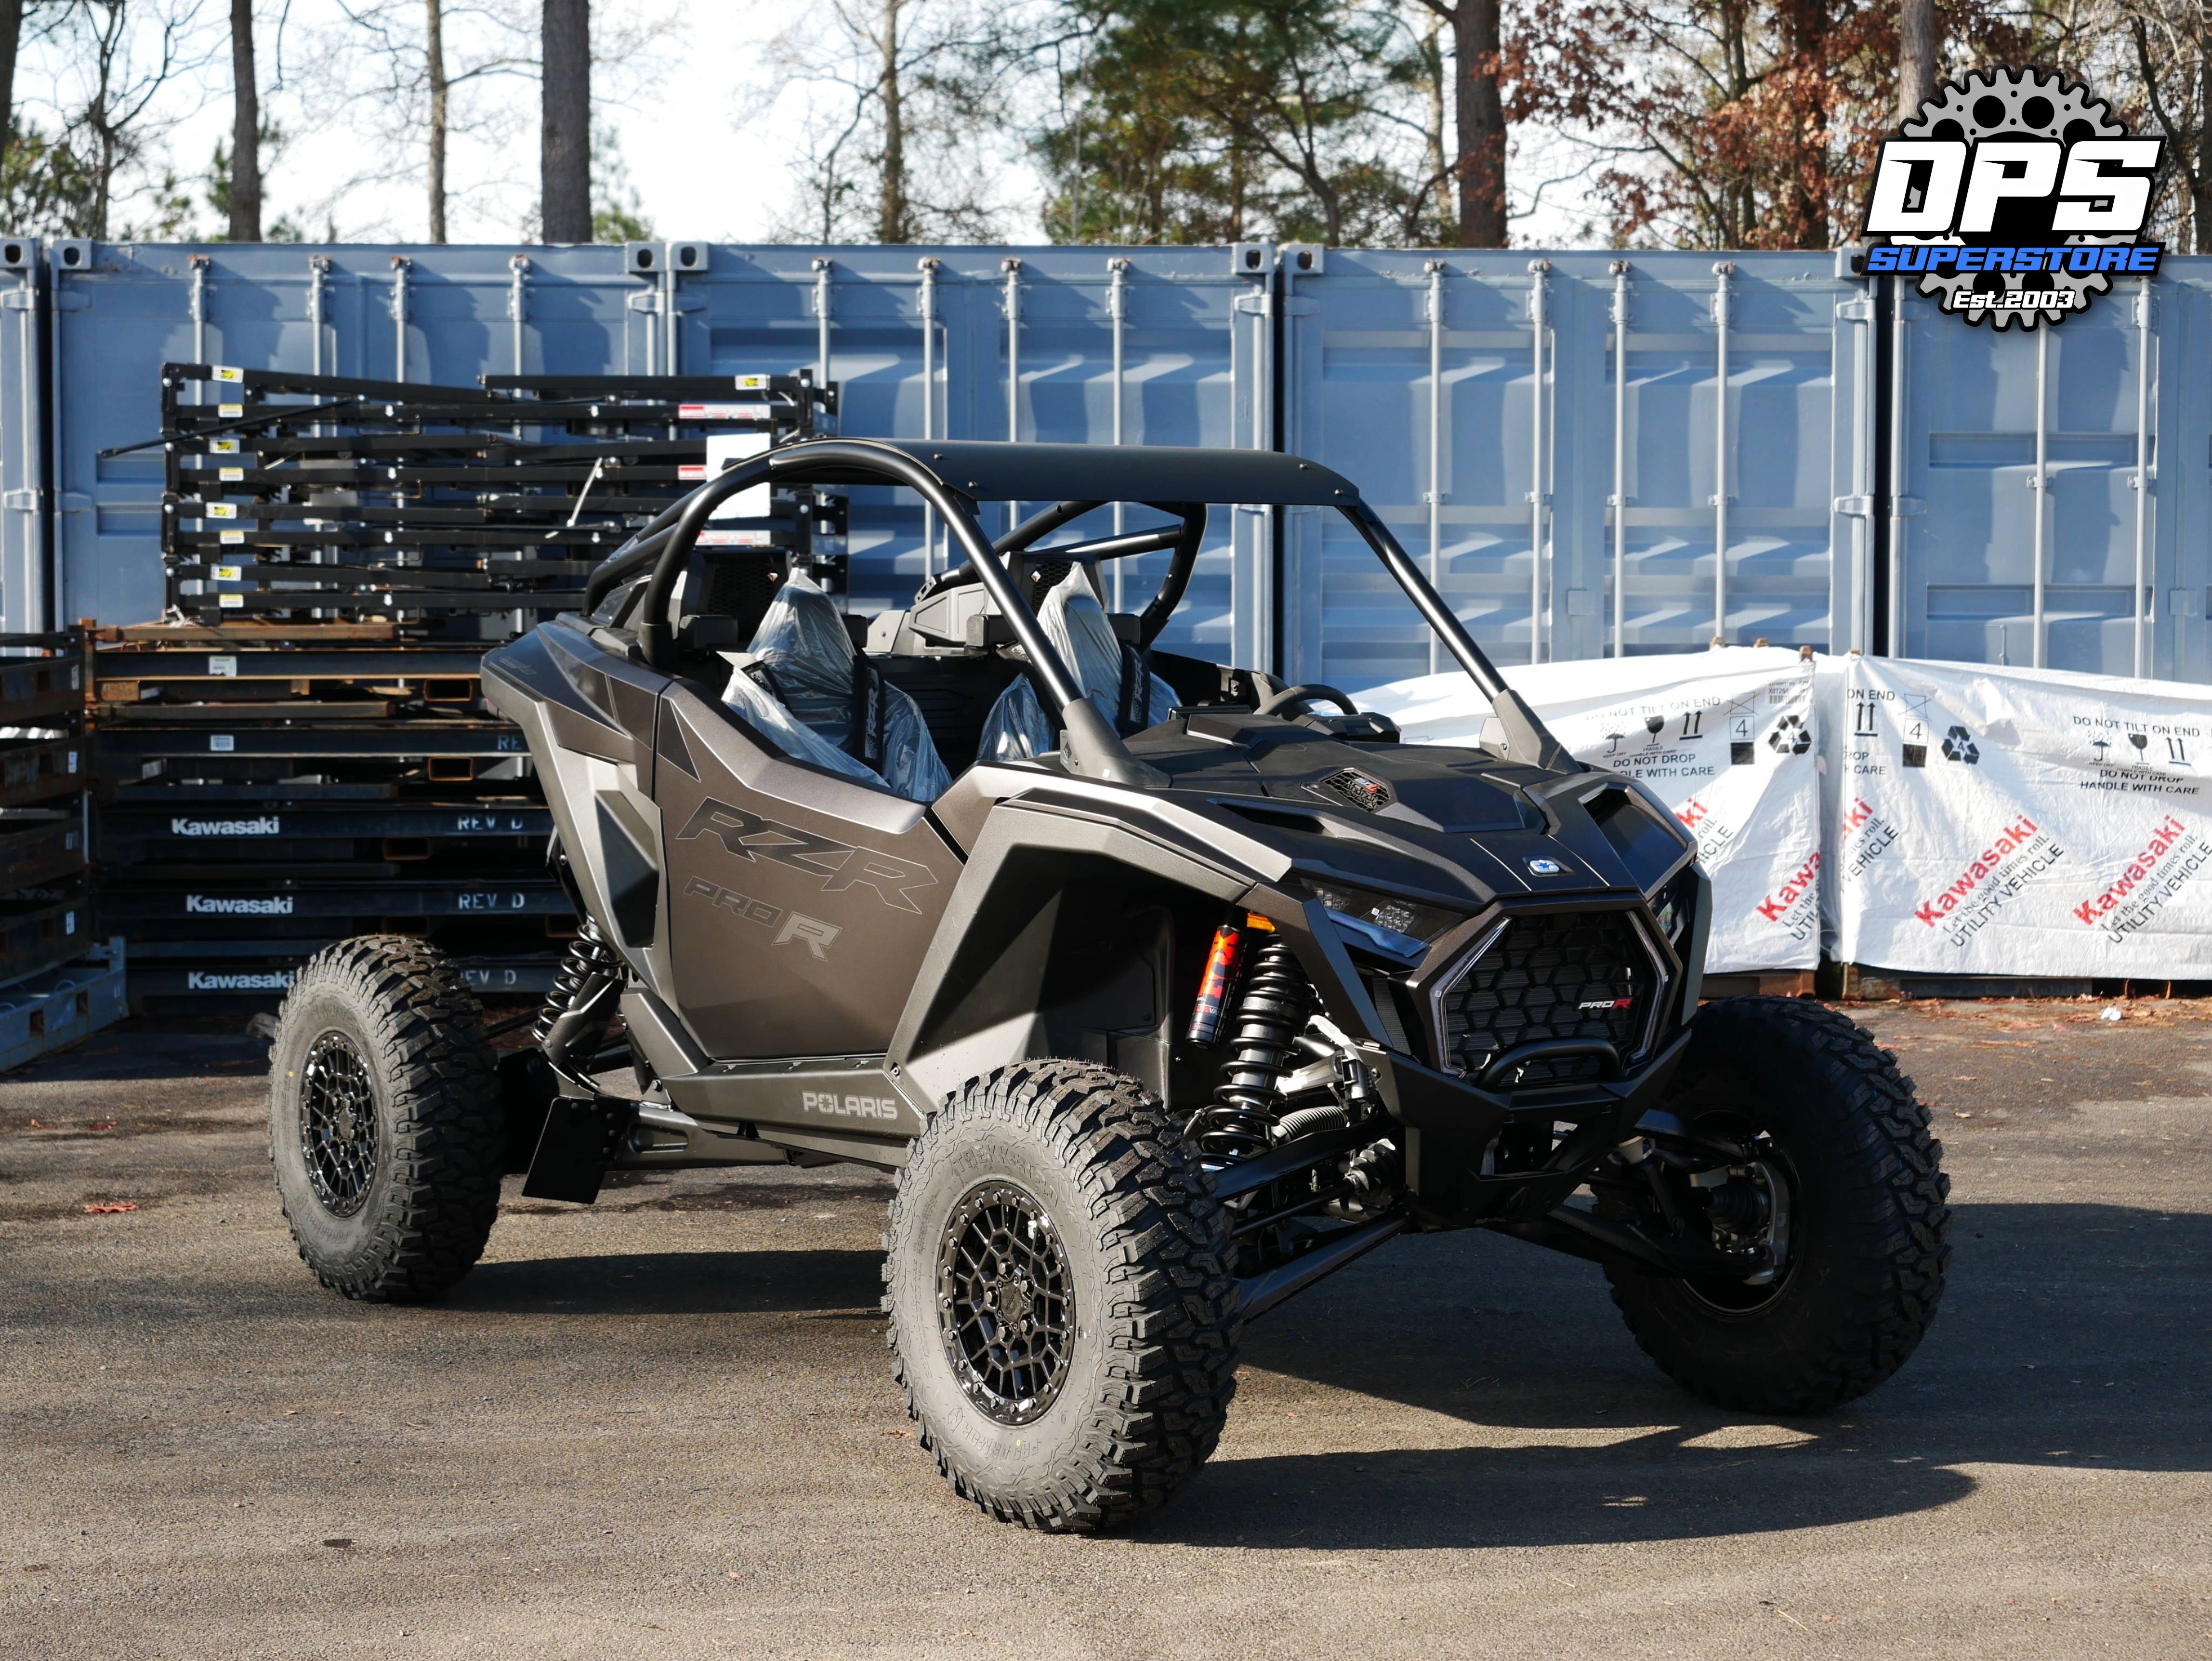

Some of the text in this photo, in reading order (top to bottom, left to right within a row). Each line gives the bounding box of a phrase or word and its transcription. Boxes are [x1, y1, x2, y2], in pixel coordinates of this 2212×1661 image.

[1847, 689, 1896, 701] ON END
[1609, 706, 1636, 717] NOT
[1639, 703, 1664, 716] TILT
[1670, 699, 1689, 711] ON
[1694, 696, 1721, 708] END
[1735, 719, 1748, 737] 4
[1909, 723, 1922, 739] 4
[2073, 716, 2200, 738] DO NOT TILT ON END
[1613, 753, 1696, 768] DO NOT DROP
[1854, 765, 1886, 775] CARE
[1646, 768, 1677, 778] WITH
[1681, 766, 1715, 776] CARE
[2100, 770, 2184, 784] DO NOT DROP
[2080, 781, 2199, 795] HANDLE WITH CARE
[172, 816, 280, 836] Kawasaki
[458, 815, 523, 830] REV D
[1864, 817, 1885, 838] roll.
[675, 796, 939, 914] RZR
[1842, 826, 1899, 883] VEHICLE
[1914, 814, 2038, 928] Kawasaki
[2073, 814, 2186, 926] Kawasaki
[2120, 900, 2139, 917] the
[2138, 877, 2159, 903] good
[2157, 854, 2181, 879] times
[2180, 834, 2199, 854] roll.
[1942, 835, 2050, 934] Let the good times roll.
[2108, 842, 2212, 944] UTILITY VEHICLE
[186, 894, 294, 914] Kawasaki
[459, 892, 525, 910] REV D
[1950, 843, 2065, 947] UTILITY VEHICLE
[683, 875, 843, 962] PRO R
[1782, 892, 1815, 928] Let the
[1198, 928, 1240, 1000] FOX
[188, 970, 295, 989] Kawasaki
[460, 969, 517, 986] EV D
[1578, 998, 1633, 1010] PRO R
[802, 1090, 898, 1120] POLARIS
